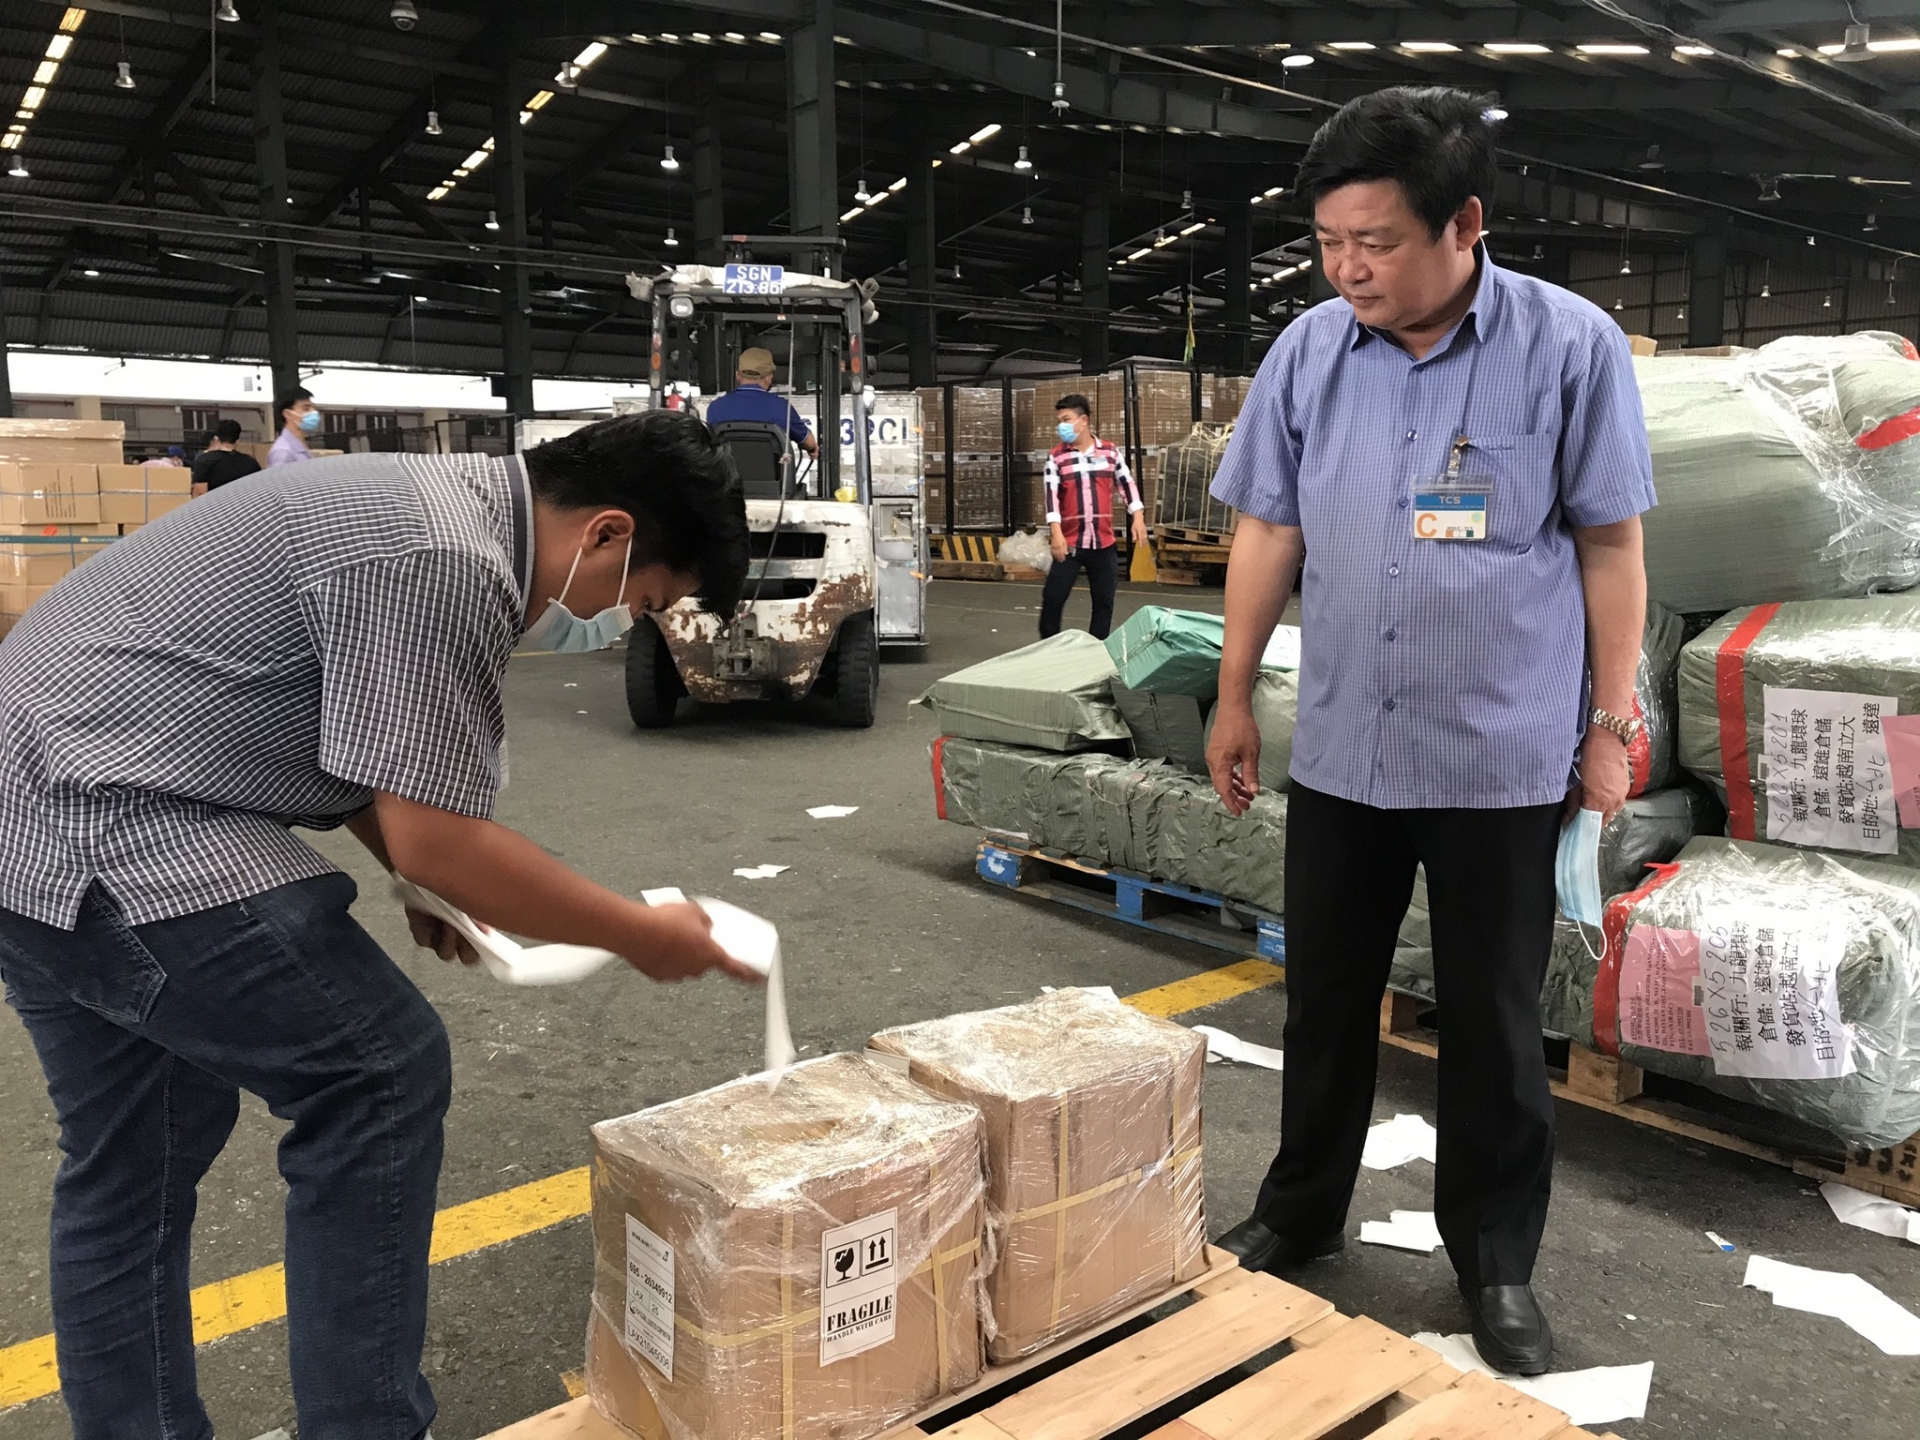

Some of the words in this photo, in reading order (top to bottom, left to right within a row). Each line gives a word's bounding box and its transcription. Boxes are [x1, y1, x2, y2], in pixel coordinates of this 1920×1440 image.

[736, 265, 772, 281] SGN
[1439, 496, 1461, 504] TCS
[1416, 513, 1437, 537] C
[1790, 708, 1808, 771] 九龍環球
[1812, 718, 1832, 781] 遠雄倉儲
[1812, 787, 1832, 818] 倉儲:
[1861, 794, 1881, 839] 目的地:
[1731, 994, 1754, 1052] 報關行:
[1757, 1003, 1779, 1043] 倉儲:
[651, 1304, 659, 1316] 25
[826, 1294, 893, 1332] FRAGILE
[826, 1327, 855, 1342] HANDLE
[856, 1321, 874, 1333] WITH
[875, 1314, 892, 1326] CARE
